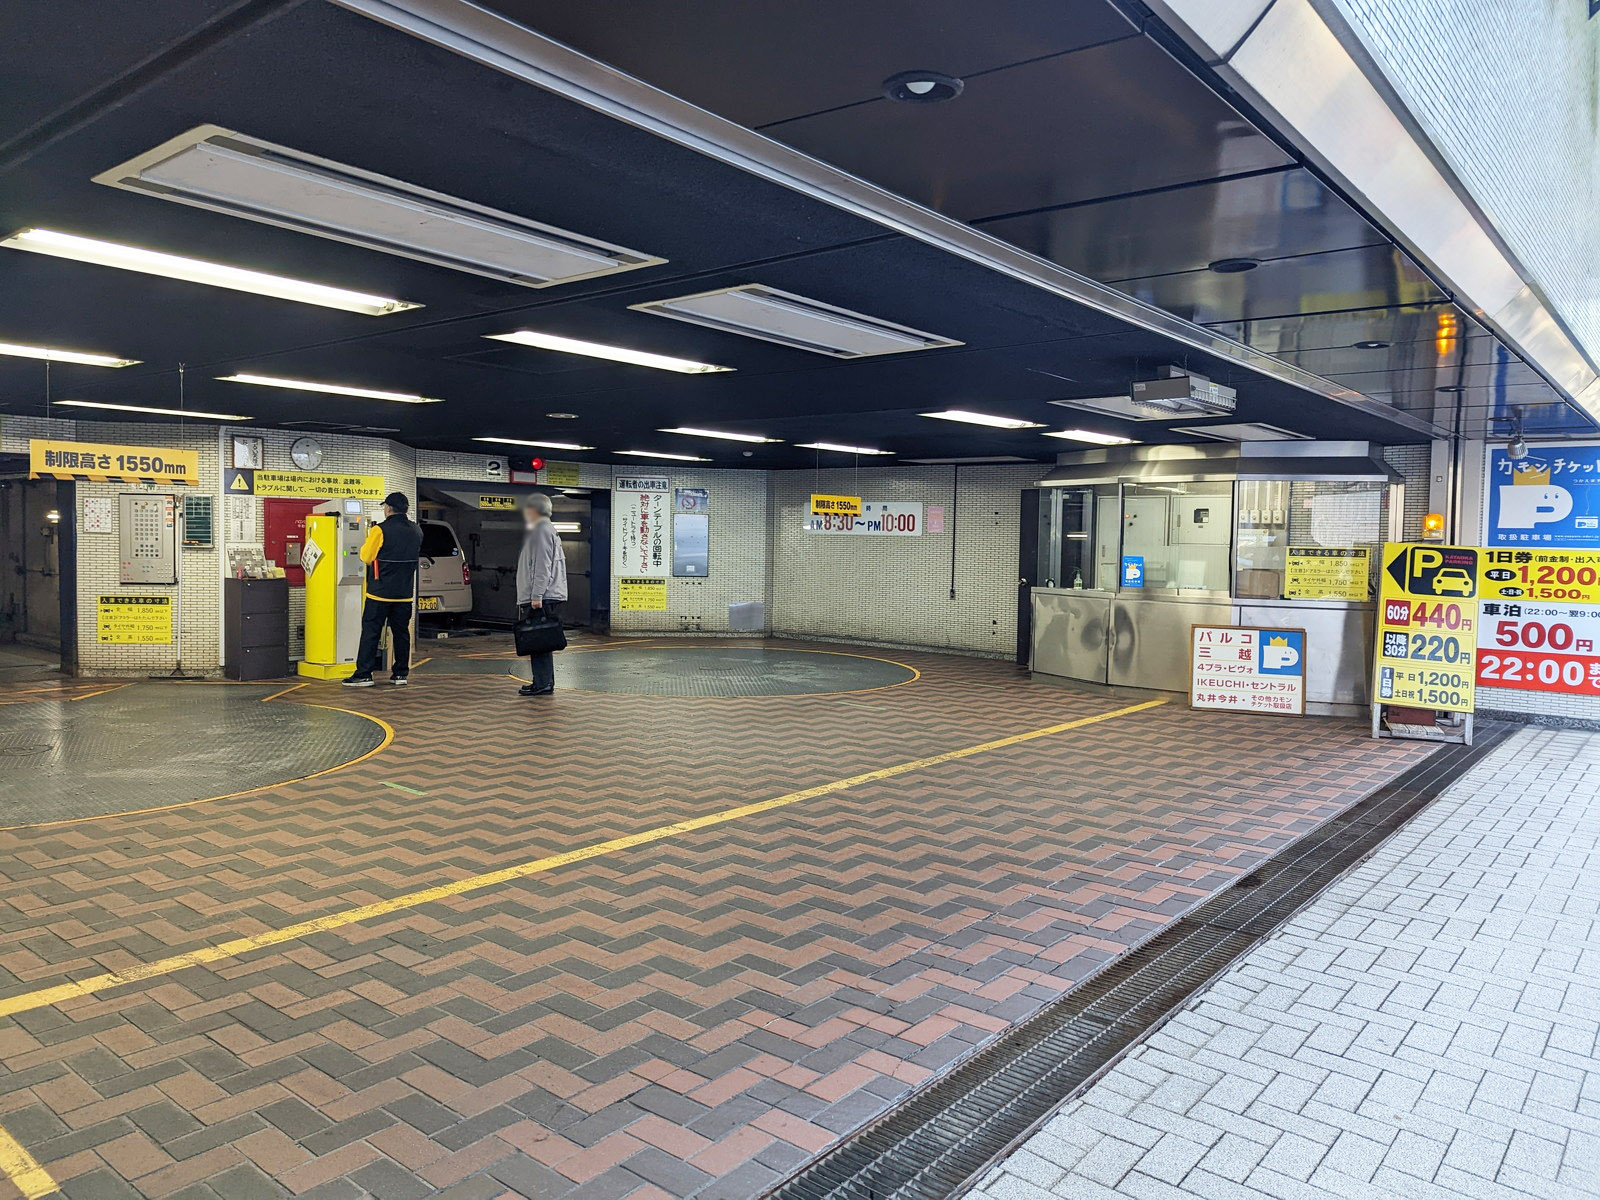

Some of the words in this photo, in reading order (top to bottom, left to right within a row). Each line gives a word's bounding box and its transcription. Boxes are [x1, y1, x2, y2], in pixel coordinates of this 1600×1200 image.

[1413, 549, 1444, 578] P
[1485, 551, 1533, 564] 1日券
[1490, 571, 1511, 580] 平日
[1387, 604, 1409, 621] 60分
[1412, 602, 1473, 631] 440円
[1482, 603, 1522, 617] 車泊
[1199, 631, 1252, 644] パルコ
[1495, 620, 1593, 652] 500円
[1199, 646, 1252, 660] 三越
[1384, 645, 1407, 657] 30分
[1410, 634, 1471, 665] 220円
[1480, 655, 1585, 686] 22:00
[1396, 672, 1416, 681] 平日
[1418, 671, 1469, 689] 1,200円
[1417, 688, 1468, 707] 1,500円
